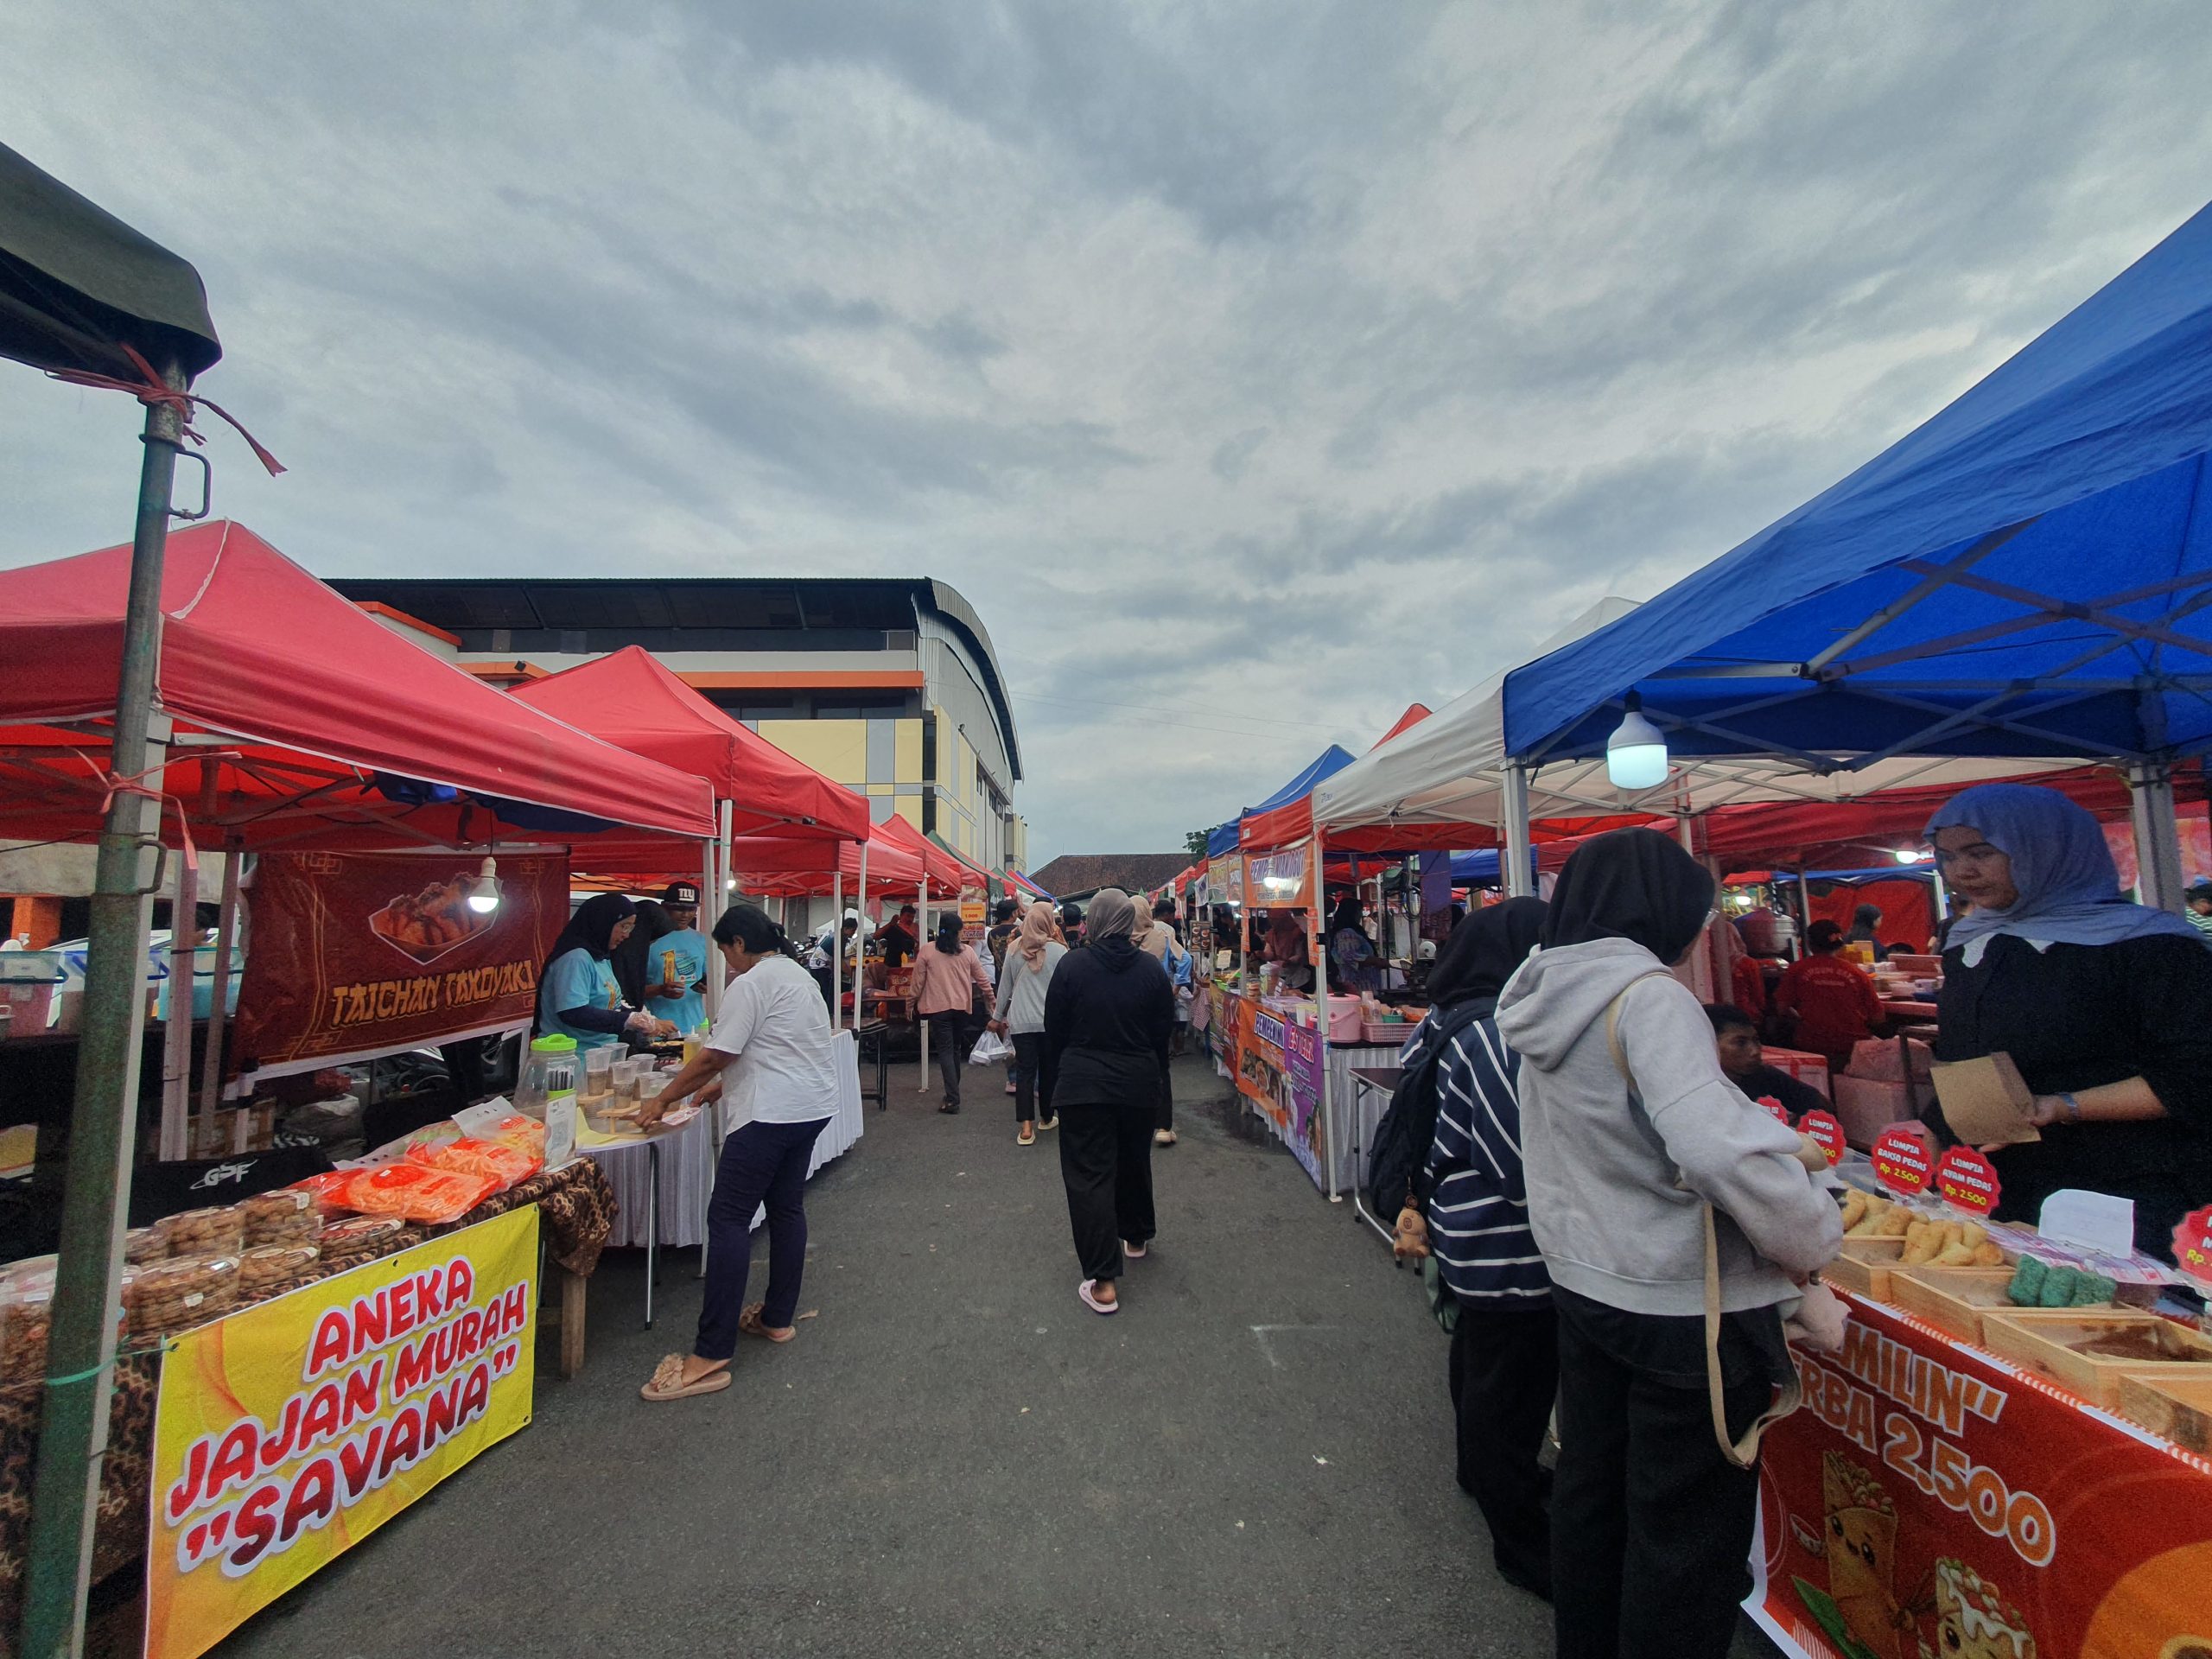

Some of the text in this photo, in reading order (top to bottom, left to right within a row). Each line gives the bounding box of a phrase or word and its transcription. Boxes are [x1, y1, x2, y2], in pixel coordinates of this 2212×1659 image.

[678, 888, 696, 901] ny
[331, 959, 537, 1027] TAICHAN TAKOYAKI
[1808, 1118, 1834, 1131] LUMPIA
[1888, 1138, 1920, 1155] LUMPIA
[1878, 1148, 1928, 1173] BAKSO PEDAS
[1951, 1157, 1984, 1175] LUMPIA
[1942, 1169, 1993, 1192] AYAM PEDAS
[306, 1257, 474, 1378] ANEKA
[1821, 1318, 2008, 1438] MILIN"
[168, 1282, 528, 1520] JAJAN MURAH
[1883, 1412, 2056, 1567] 2.500
